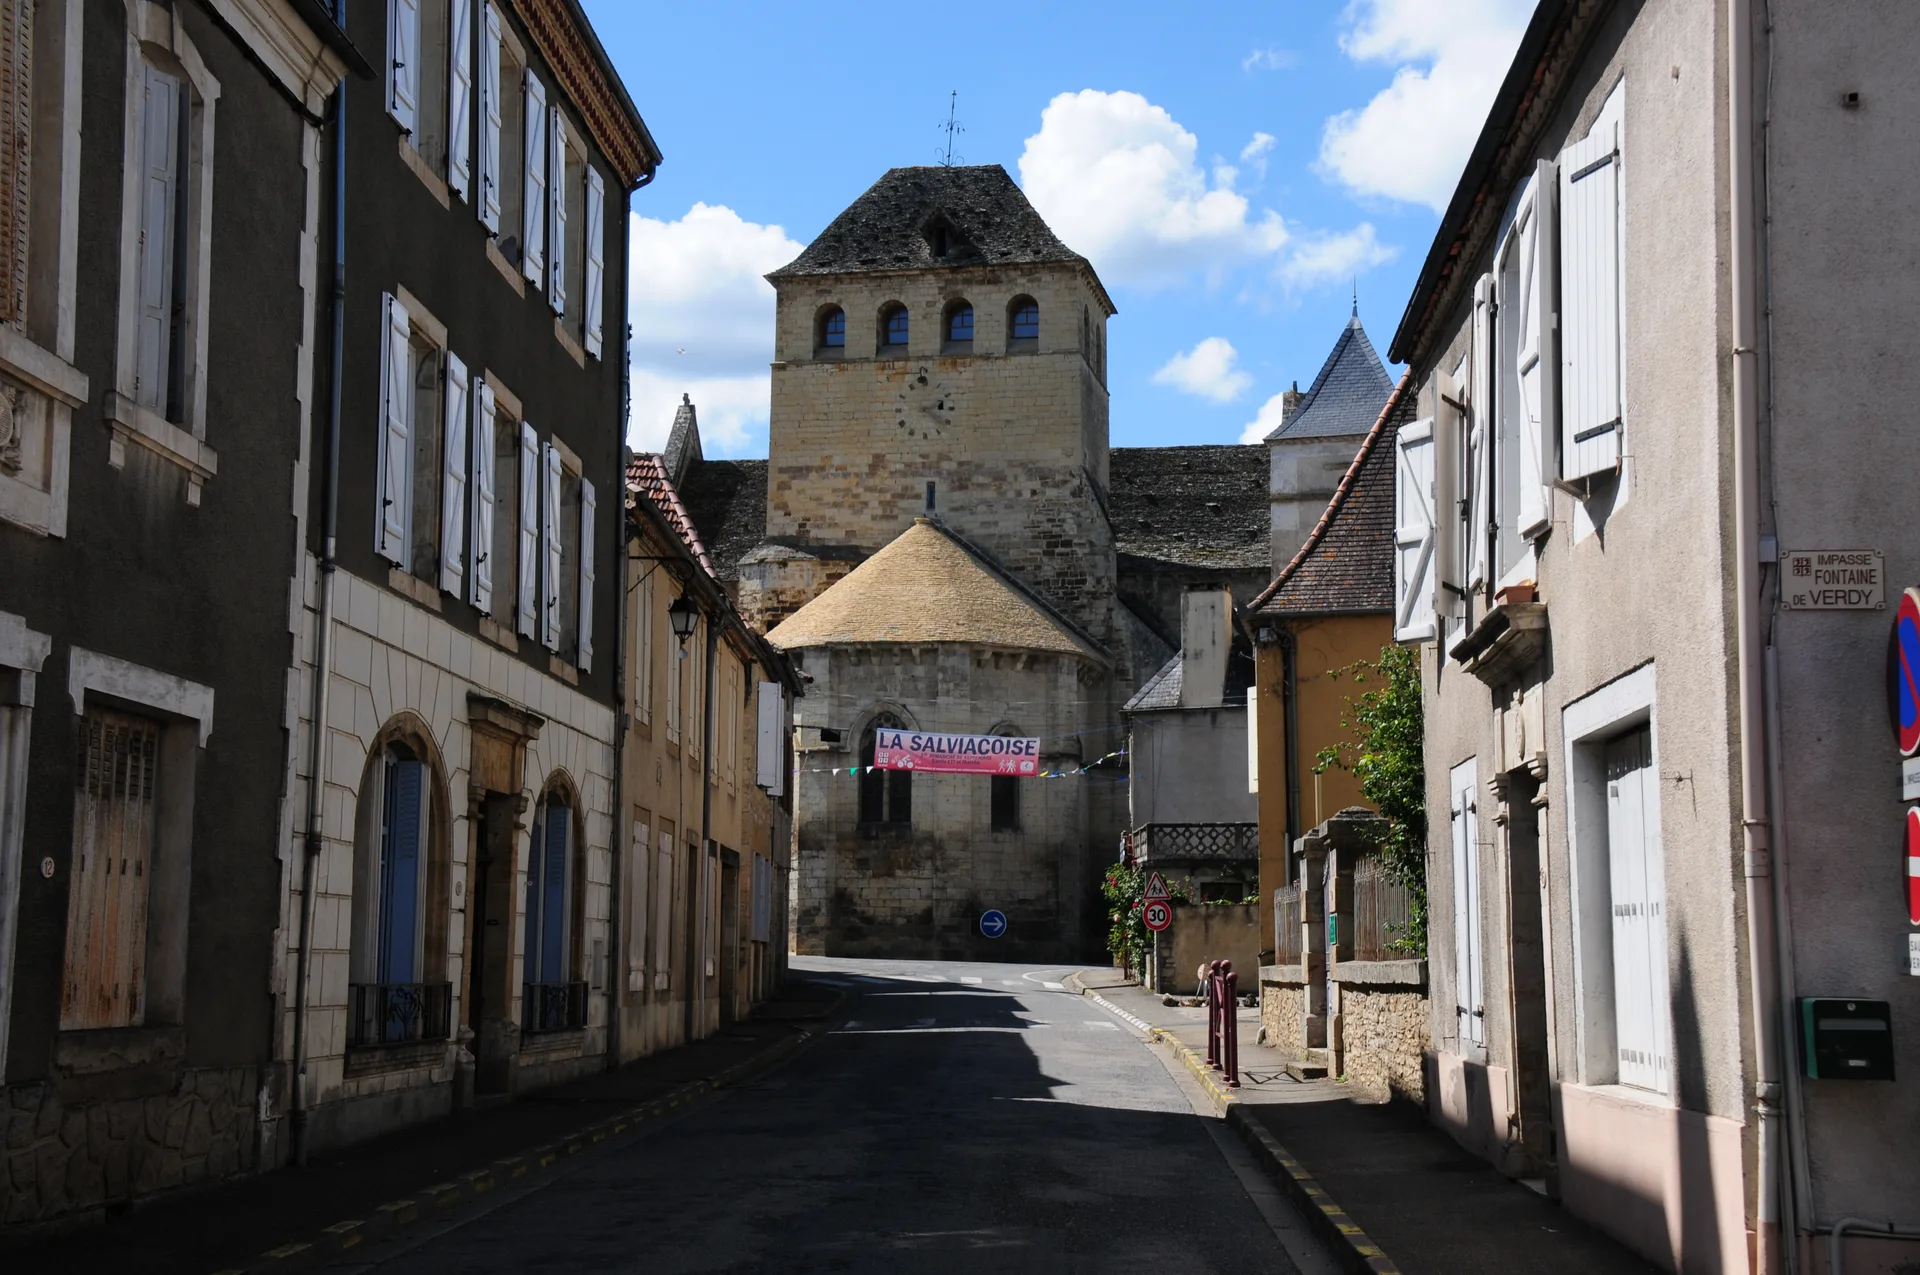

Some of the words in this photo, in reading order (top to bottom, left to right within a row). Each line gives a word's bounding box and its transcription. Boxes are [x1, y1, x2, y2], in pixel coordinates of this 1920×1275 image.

[1817, 554, 1872, 566] IMPASSE
[1815, 569, 1877, 585] FONTAINE
[1793, 594, 1806, 606] DE
[1809, 589, 1873, 605] VERDY
[879, 732, 903, 750] LA
[909, 735, 1037, 756] SALVIACOISE
[44, 860, 53, 876] 12
[1148, 908, 1166, 922] 30
